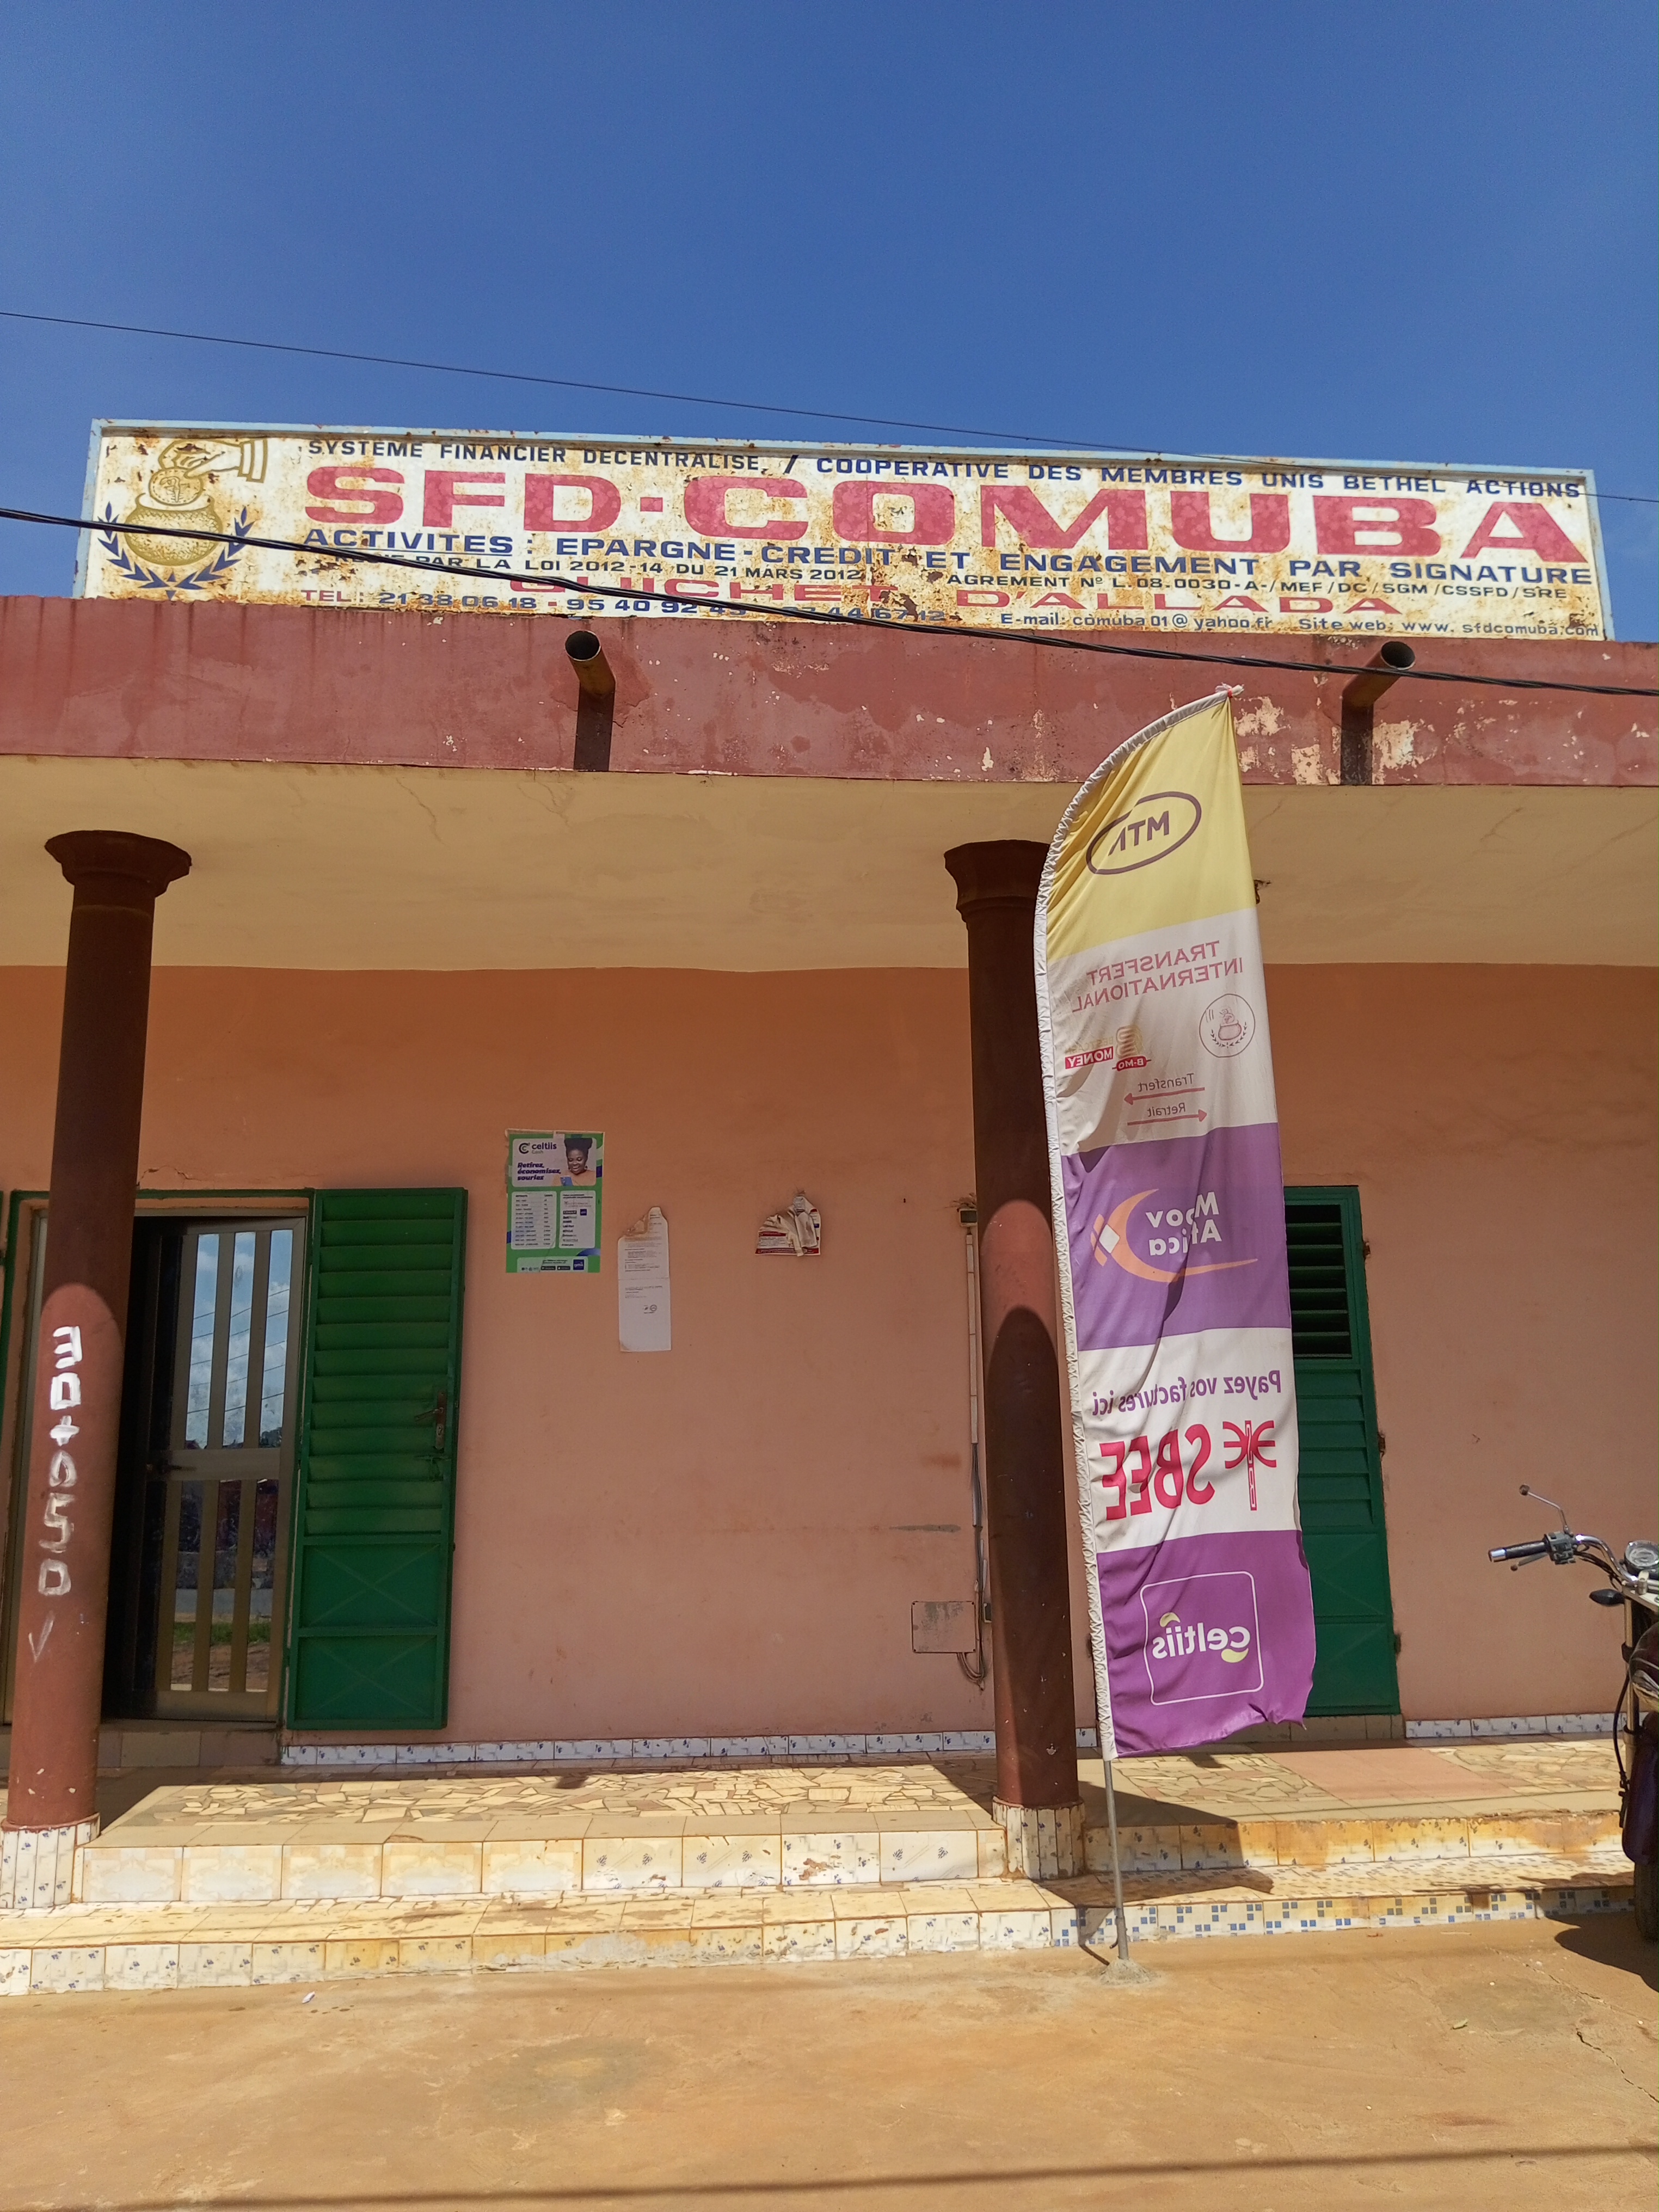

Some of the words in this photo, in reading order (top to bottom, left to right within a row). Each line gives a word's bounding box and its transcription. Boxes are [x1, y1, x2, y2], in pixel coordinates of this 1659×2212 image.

[308, 440, 423, 458] SYSTEME
[440, 444, 566, 463] FINANCIER
[583, 449, 759, 471] DECENTRALISE
[816, 458, 1009, 478] COOPERATIVE
[1028, 464, 1081, 481] DES
[1101, 467, 1243, 486] MEMBRES
[1261, 472, 1324, 489] UNIS
[1343, 475, 1446, 493] BETHEL
[1465, 480, 1580, 497] ACTIONS
[476, 557, 511, 570] LA
[525, 560, 560, 571] LOI
[676, 563, 704, 575] DU
[715, 566, 736, 576] 21
[746, 567, 803, 580] MARS
[810, 569, 862, 581] 2012
[947, 574, 1070, 587] AGREMENT
[925, 551, 970, 569] ET
[1000, 554, 1259, 575] ENGAGEMENT
[1289, 560, 1361, 578] PAR
[1390, 562, 1593, 585] SIGNATURE
[615, 599, 650, 611] 40
[956, 589, 1403, 615] D'ALLADA
[1298, 617, 1343, 630] Site
